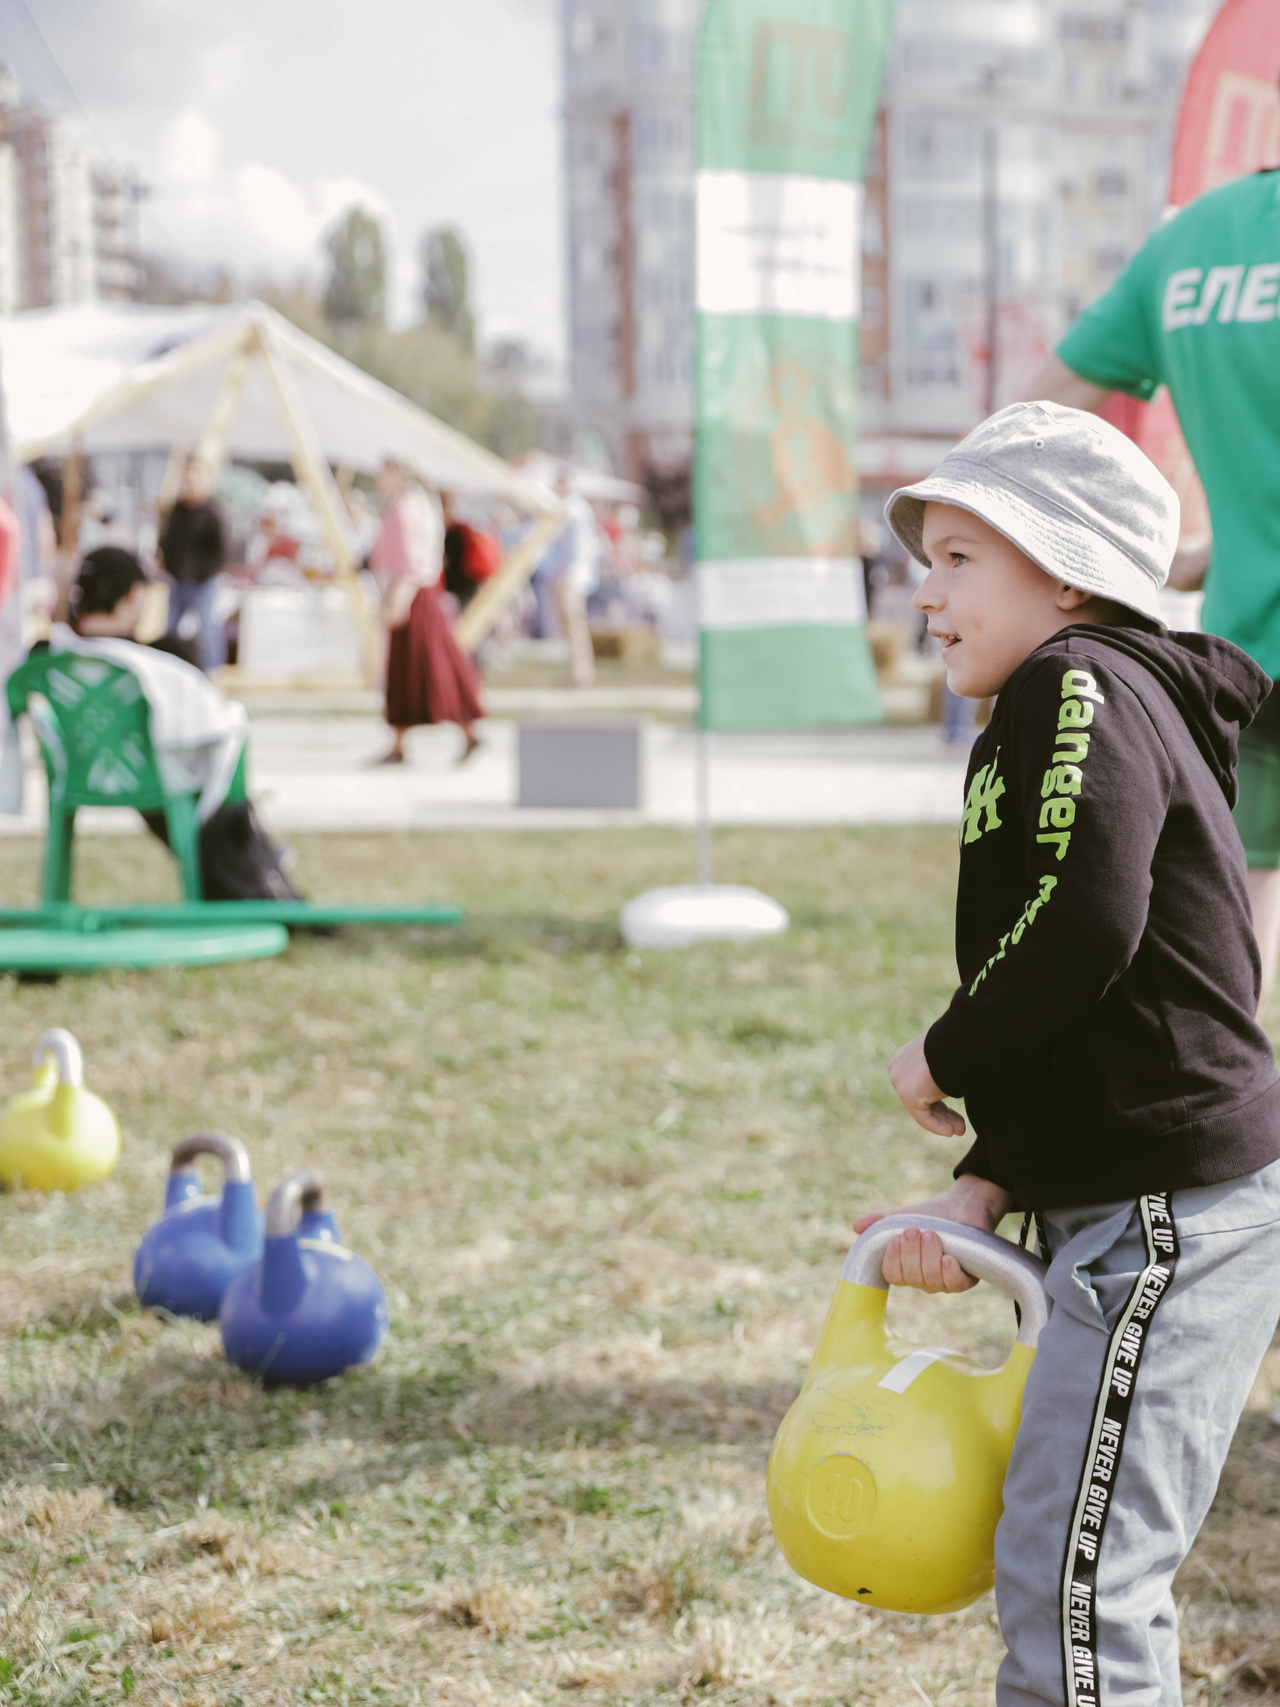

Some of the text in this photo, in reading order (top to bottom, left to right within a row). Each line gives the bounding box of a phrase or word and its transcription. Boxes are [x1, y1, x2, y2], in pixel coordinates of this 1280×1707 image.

[1036, 668, 1105, 862] danger
[1147, 1190, 1175, 1254] IVE UP
[1111, 1264, 1170, 1398] NEVER GIVE UP
[1077, 1416, 1122, 1562] NEVER GIVE UP
[1070, 1580, 1097, 1707] NEVER GIVE U
